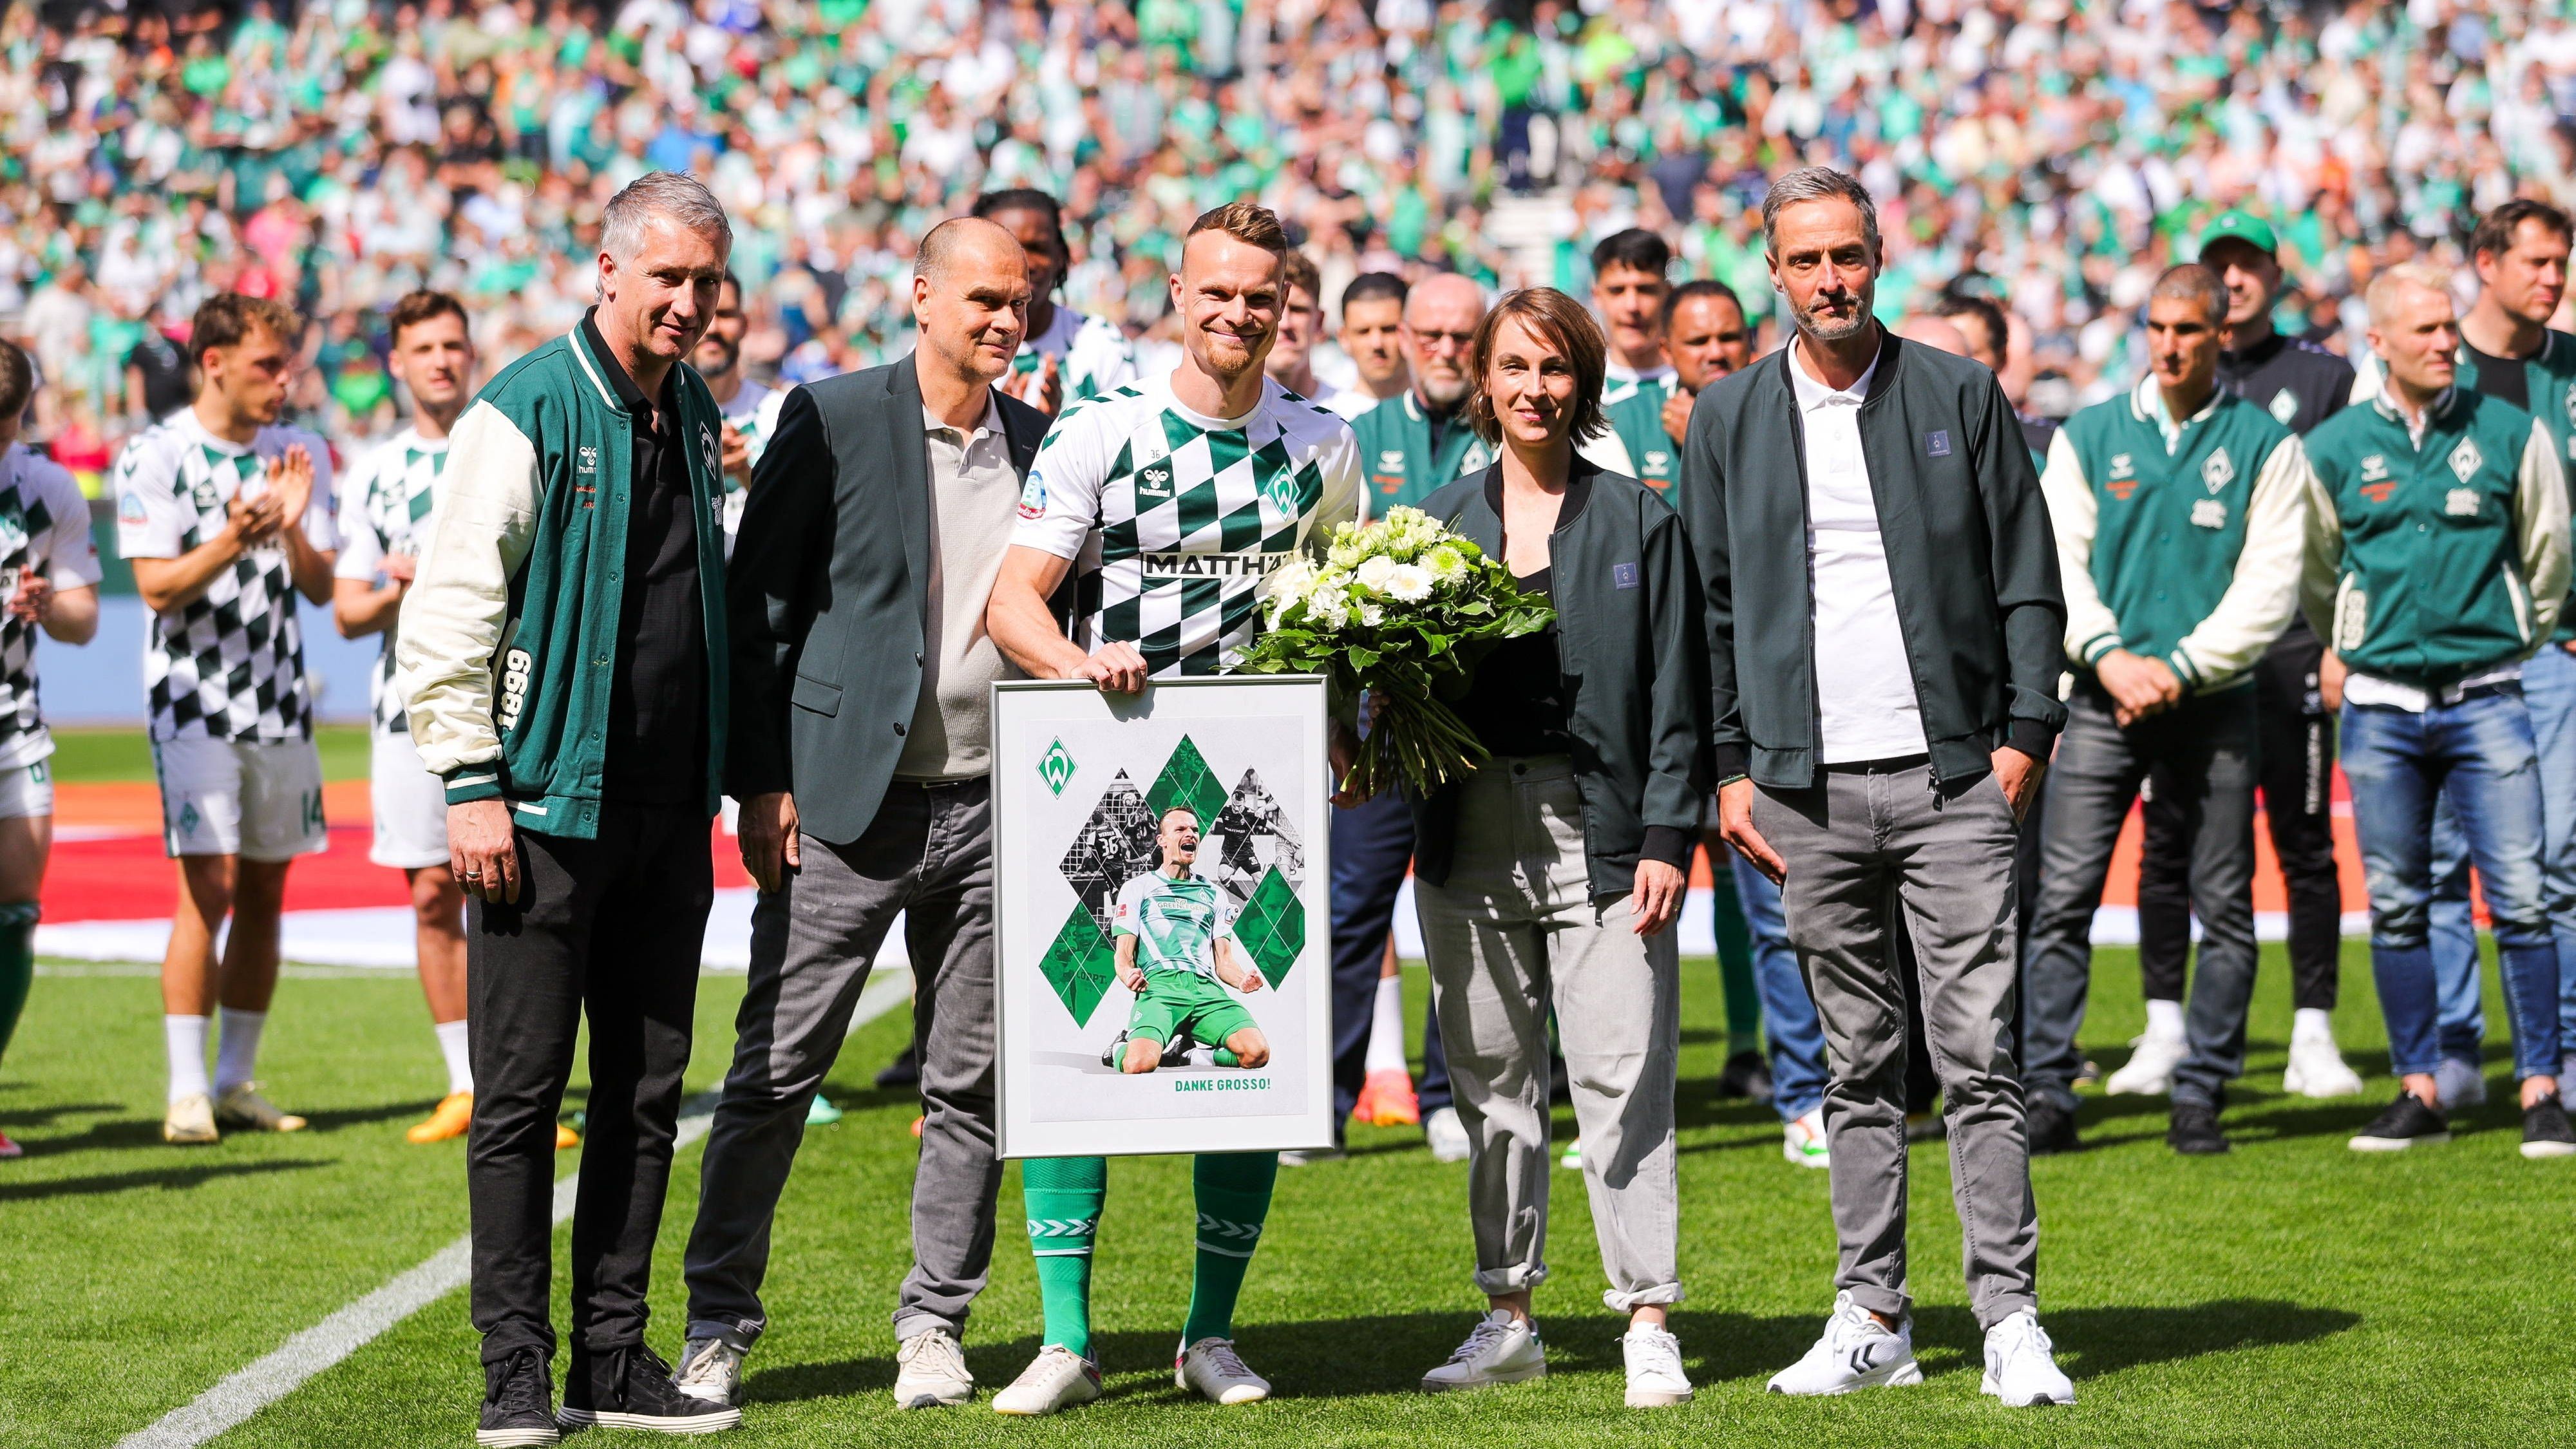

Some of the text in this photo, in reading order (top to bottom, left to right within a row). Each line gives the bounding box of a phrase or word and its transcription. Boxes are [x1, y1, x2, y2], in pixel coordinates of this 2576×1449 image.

[1150, 450, 1160, 459] 36
[1139, 486, 1171, 498] hummel
[497, 649, 532, 732] 1899
[1098, 835, 1119, 857] 36
[1175, 1078, 1271, 1092] DANKE GROSSO!
